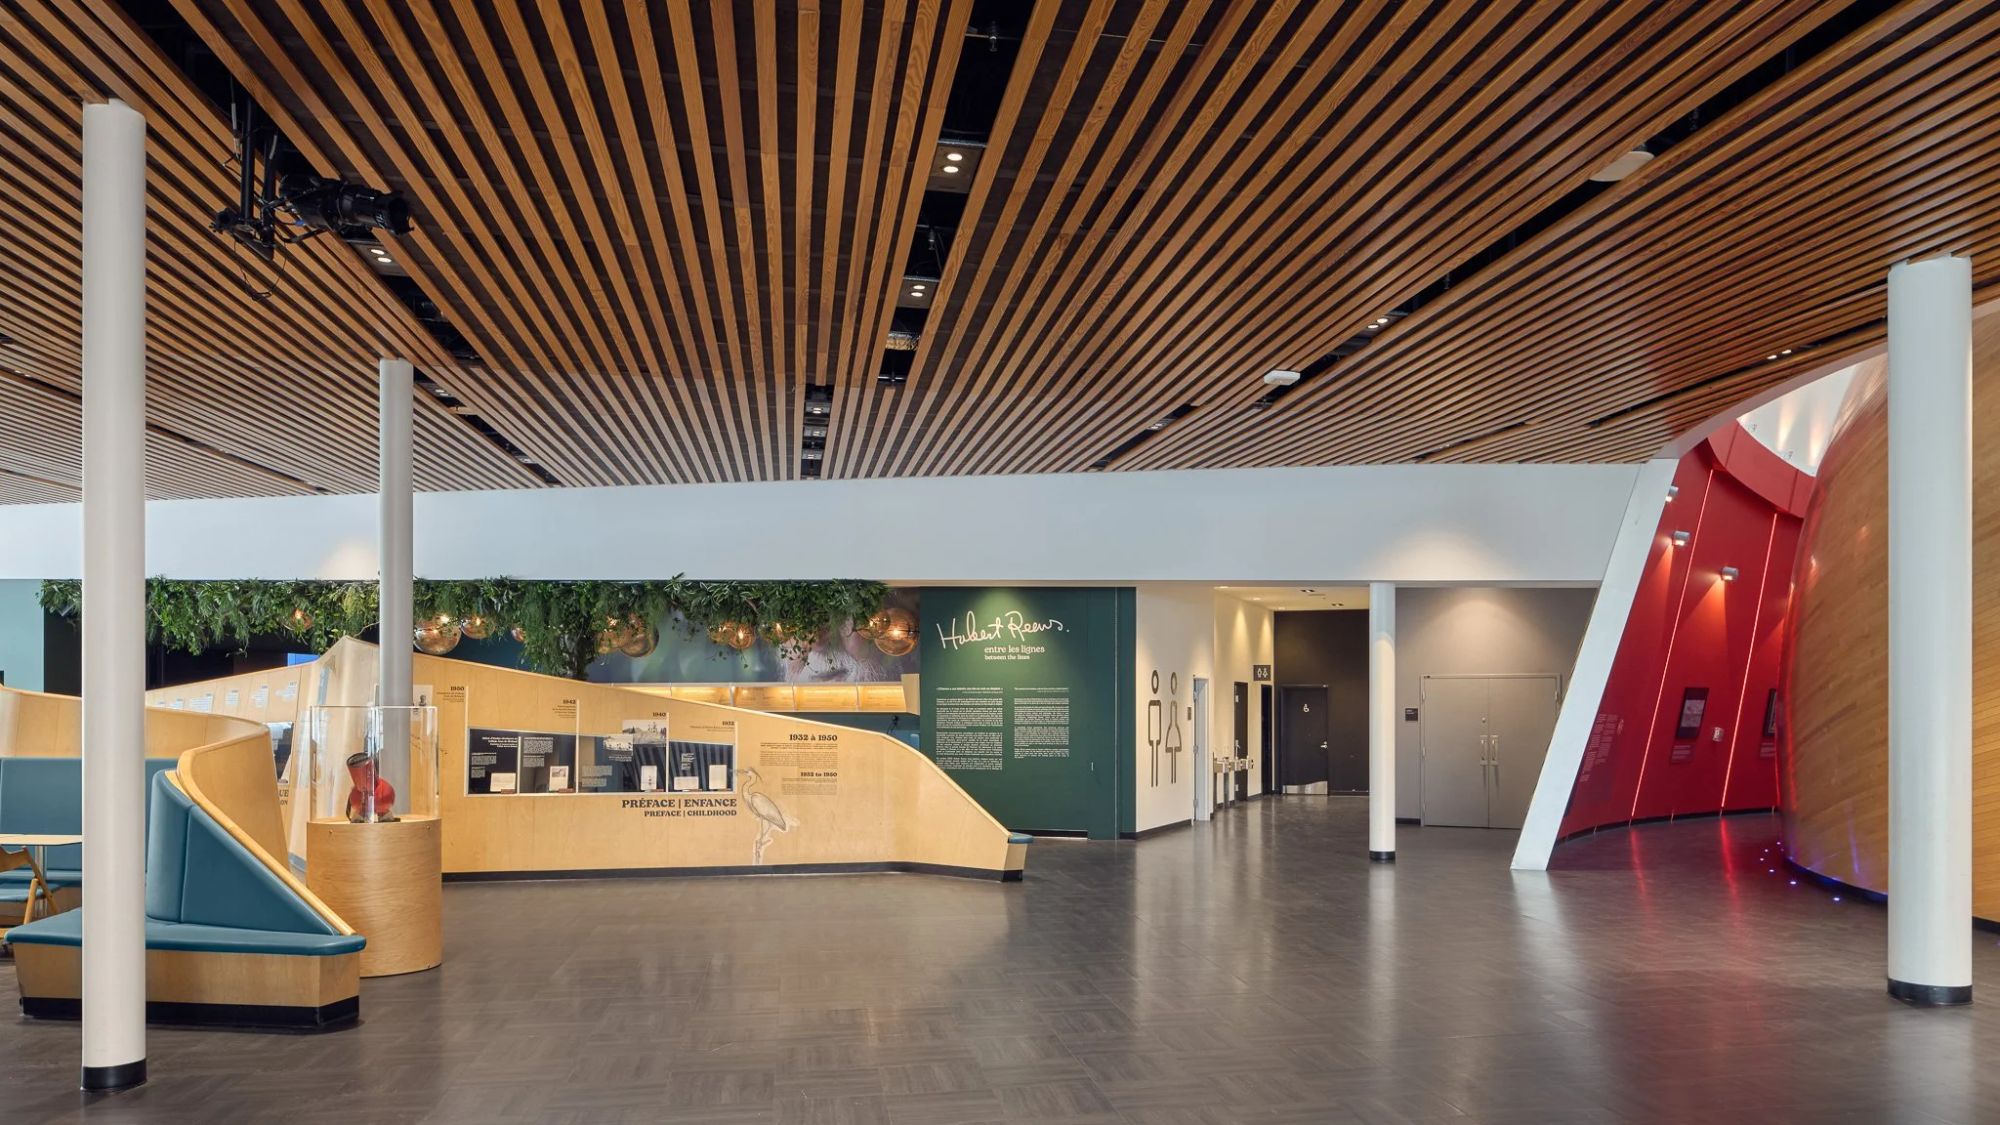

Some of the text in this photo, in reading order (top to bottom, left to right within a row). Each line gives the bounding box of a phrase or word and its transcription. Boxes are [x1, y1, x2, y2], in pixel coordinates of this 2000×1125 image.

[936, 610, 1004, 650] Hubert
[1008, 644, 1020, 653] les
[1020, 644, 1045, 655] lignes
[789, 733, 838, 742] 1932 à 1950
[622, 798, 676, 808] PRÉFACE
[684, 798, 737, 808] ENFANCE
